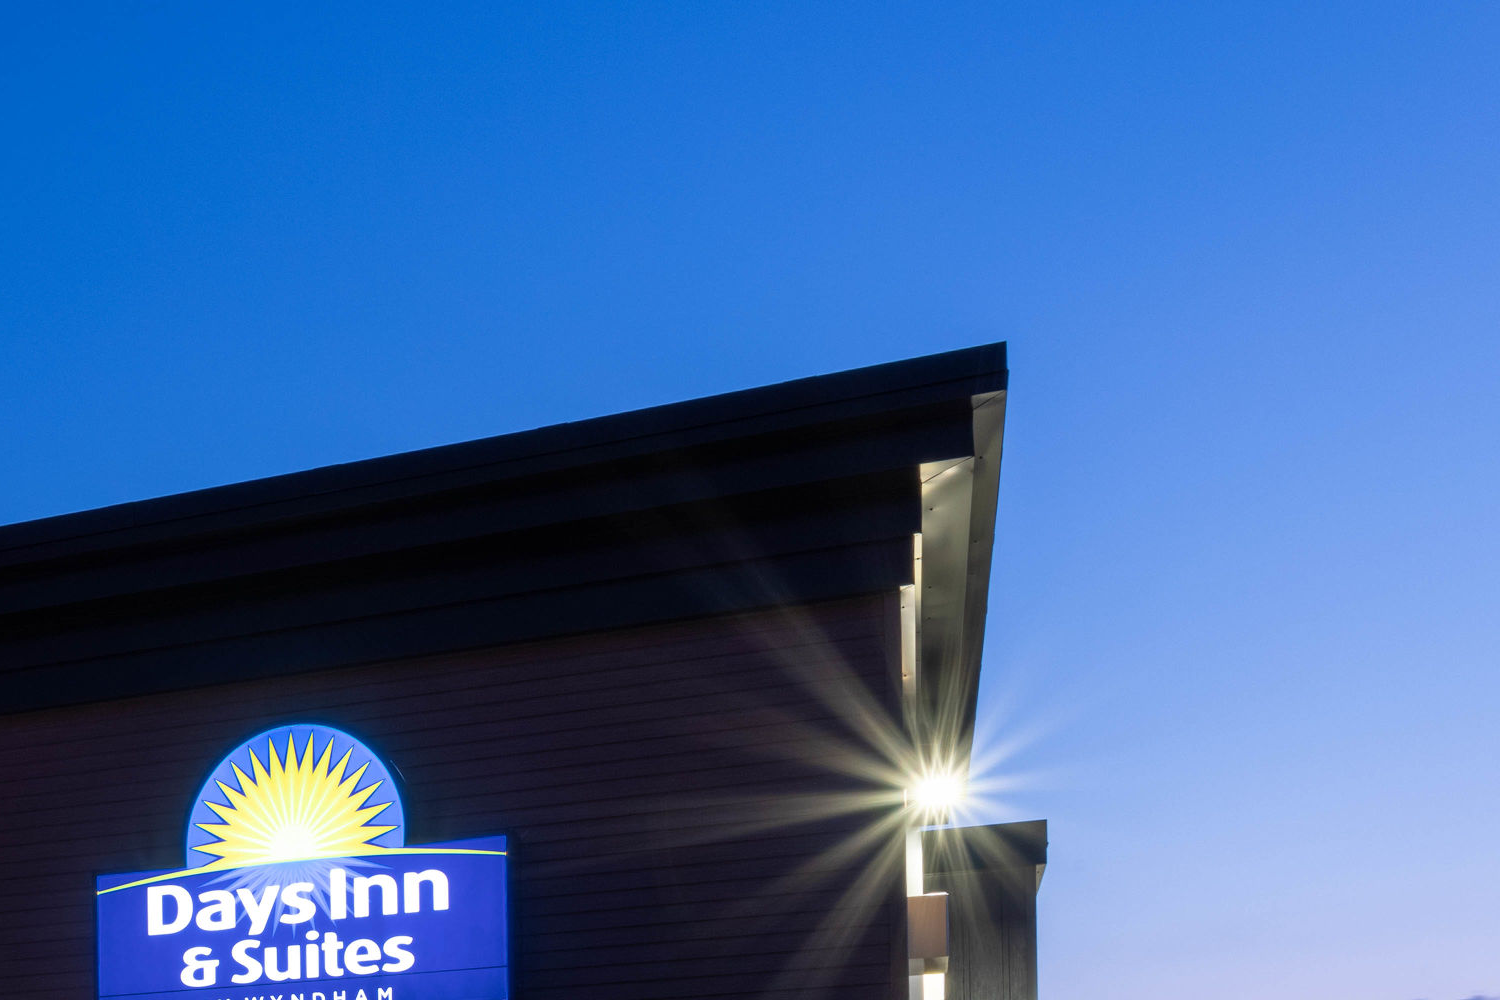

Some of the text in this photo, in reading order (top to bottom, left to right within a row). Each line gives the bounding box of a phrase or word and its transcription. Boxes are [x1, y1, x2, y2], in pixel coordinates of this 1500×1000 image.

[146, 868, 450, 936] Days Inn
[180, 930, 416, 988] & Suites
